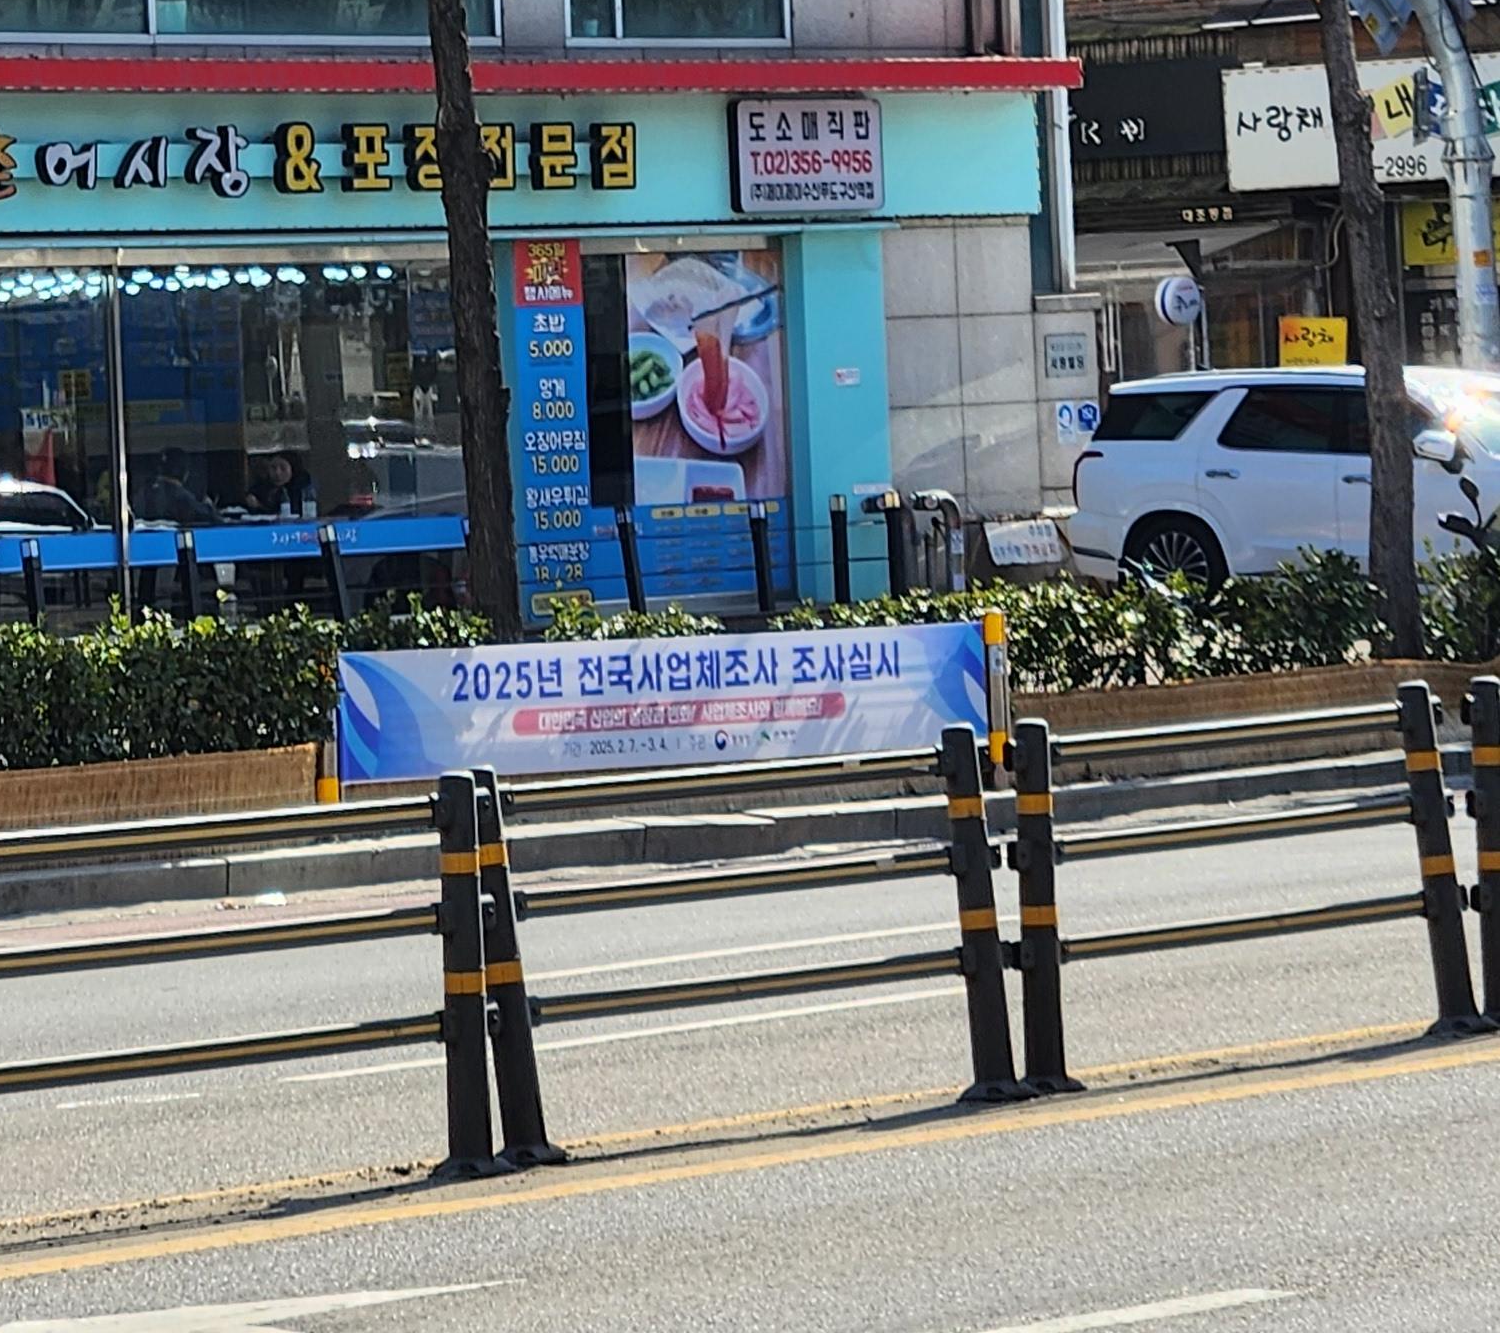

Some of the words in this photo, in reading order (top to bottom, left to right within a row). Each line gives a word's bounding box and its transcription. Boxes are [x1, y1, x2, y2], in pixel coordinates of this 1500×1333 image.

[1236, 104, 1324, 142] 사랑채
[279, 122, 324, 193] &
[452, 662, 564, 704] 2025년
[577, 645, 779, 696] 전국사업체조사
[791, 638, 901, 681] 조사실시
